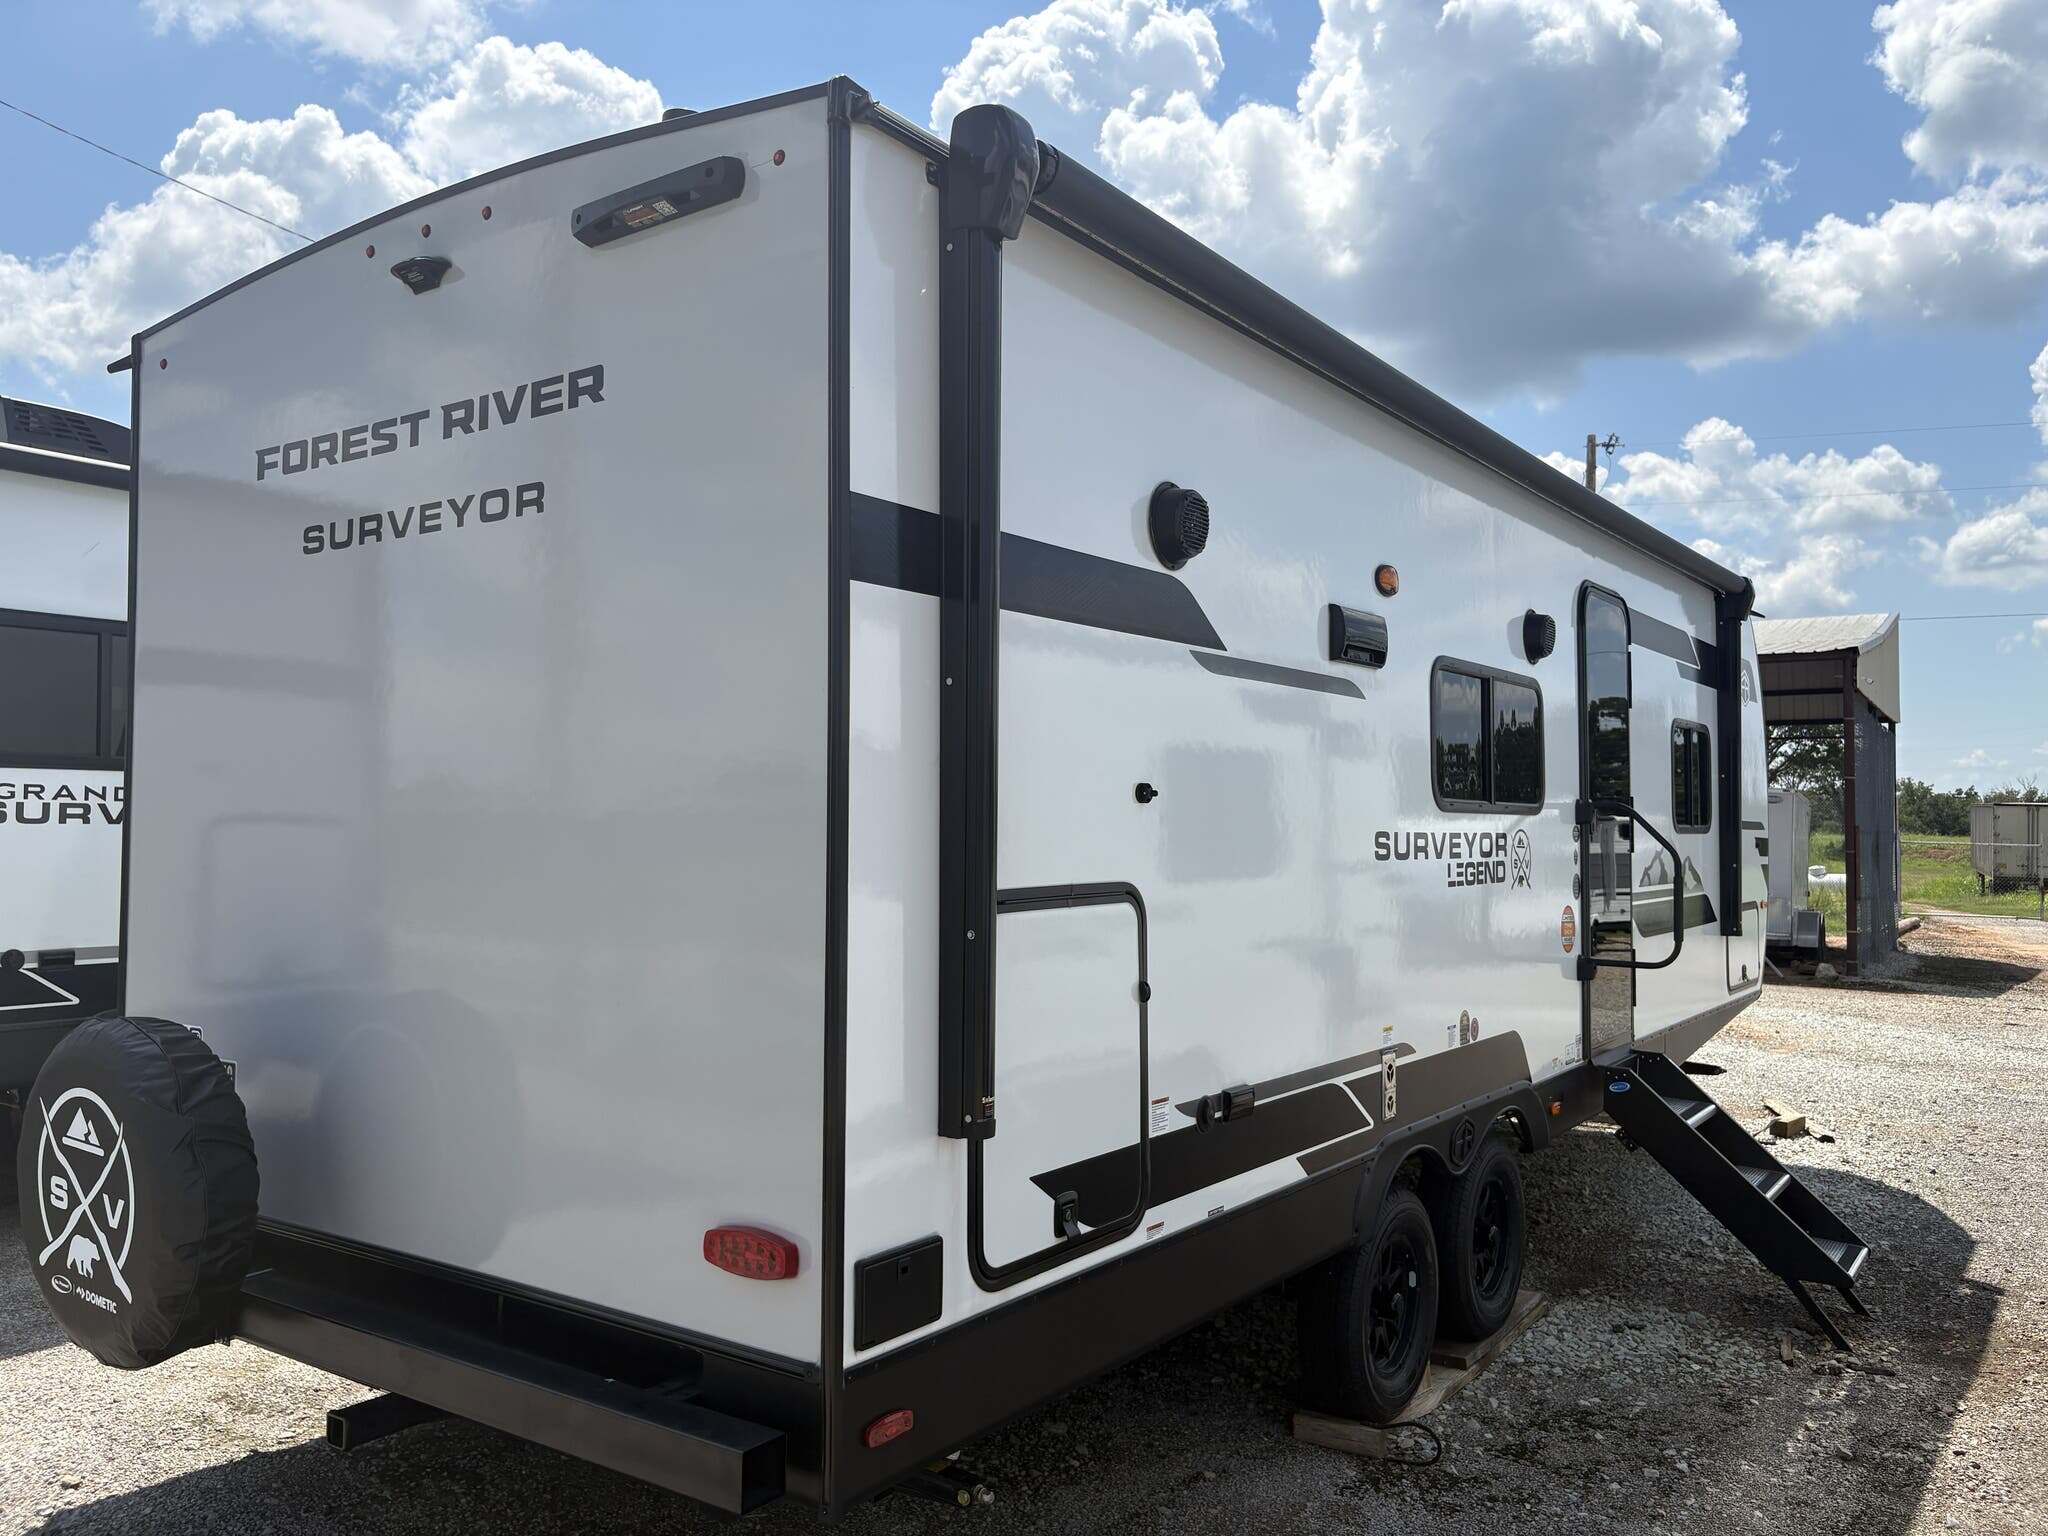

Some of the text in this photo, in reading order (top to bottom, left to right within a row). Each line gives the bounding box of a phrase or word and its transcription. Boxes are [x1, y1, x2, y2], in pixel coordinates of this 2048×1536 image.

[255, 364, 605, 481] FOREST RIVER
[302, 481, 545, 555] SURVEYOR
[0, 802, 124, 824] URV
[1374, 831, 1508, 861] SURVEYOR
[1447, 860, 1506, 887] LEGEND
[50, 1175, 125, 1229] S V
[85, 1289, 117, 1314] DOMETIC
